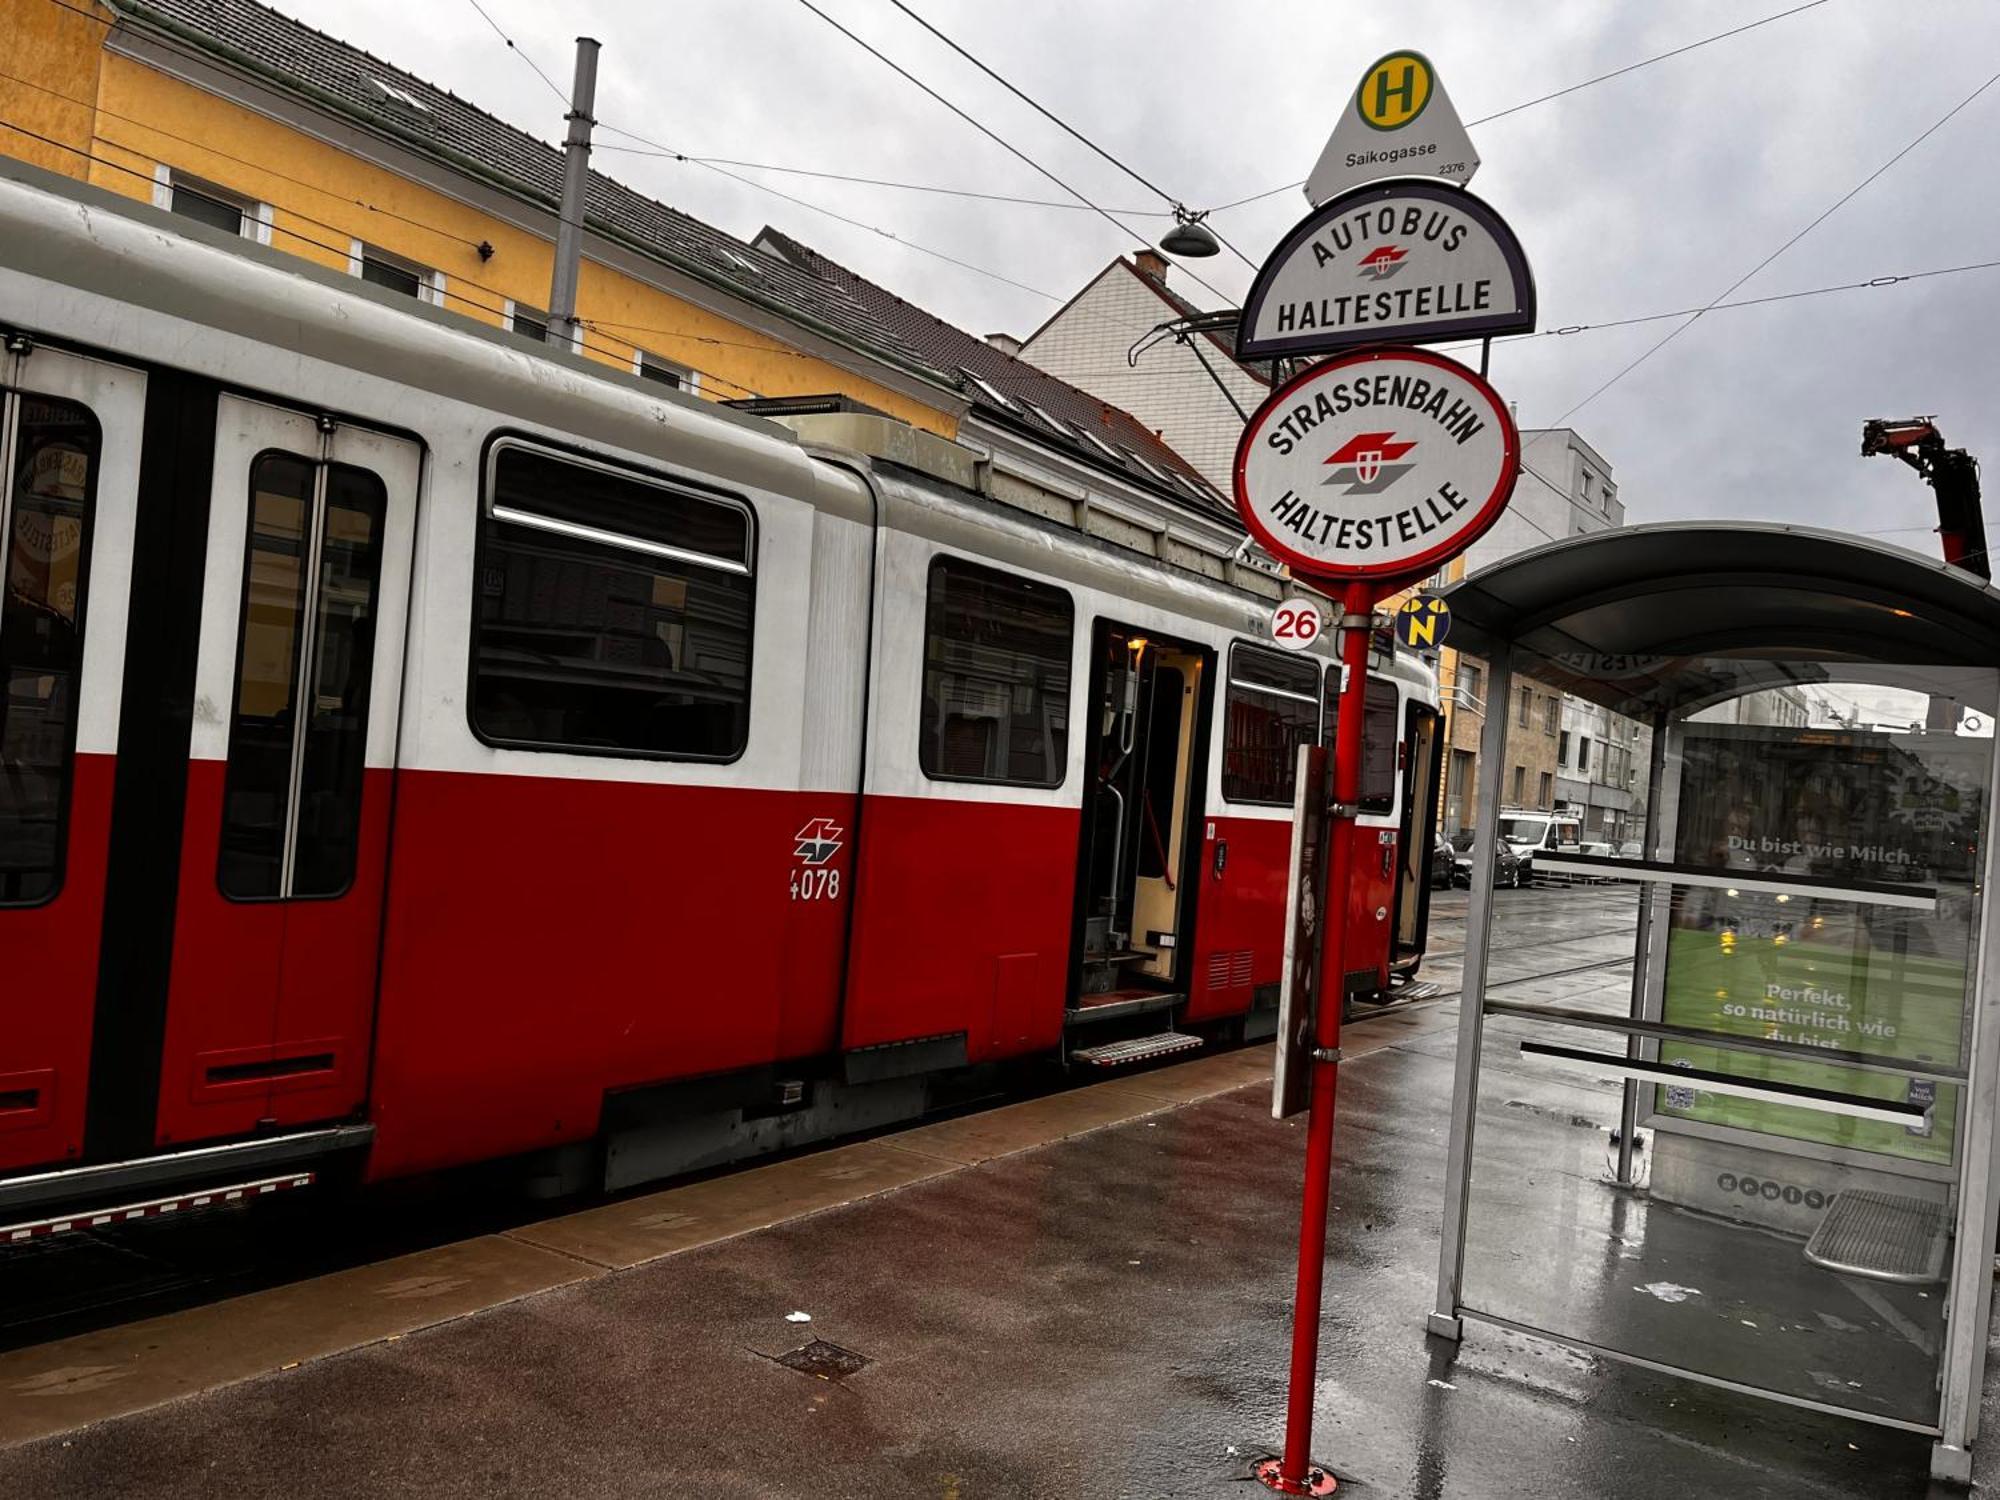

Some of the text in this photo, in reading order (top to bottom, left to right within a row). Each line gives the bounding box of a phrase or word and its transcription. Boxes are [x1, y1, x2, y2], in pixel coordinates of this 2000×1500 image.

[1375, 65, 1414, 118] H
[1345, 142, 1437, 168] Saikogasse
[1439, 162, 1465, 175] 2376
[1311, 206, 1467, 268] AUTOBUS
[1277, 279, 1491, 332] HALTESTELLE
[1268, 375, 1485, 455] STRASSENBAHN
[1270, 482, 1469, 550] HALTESTELLE
[1275, 609, 1317, 639] 26
[1408, 615, 1436, 646] N
[1728, 835, 1918, 865] Du bist wie Milch.
[790, 869, 840, 900] 4078
[1767, 983, 1851, 1010] Perfekt,
[1722, 1002, 1896, 1038] so natürlich wie
